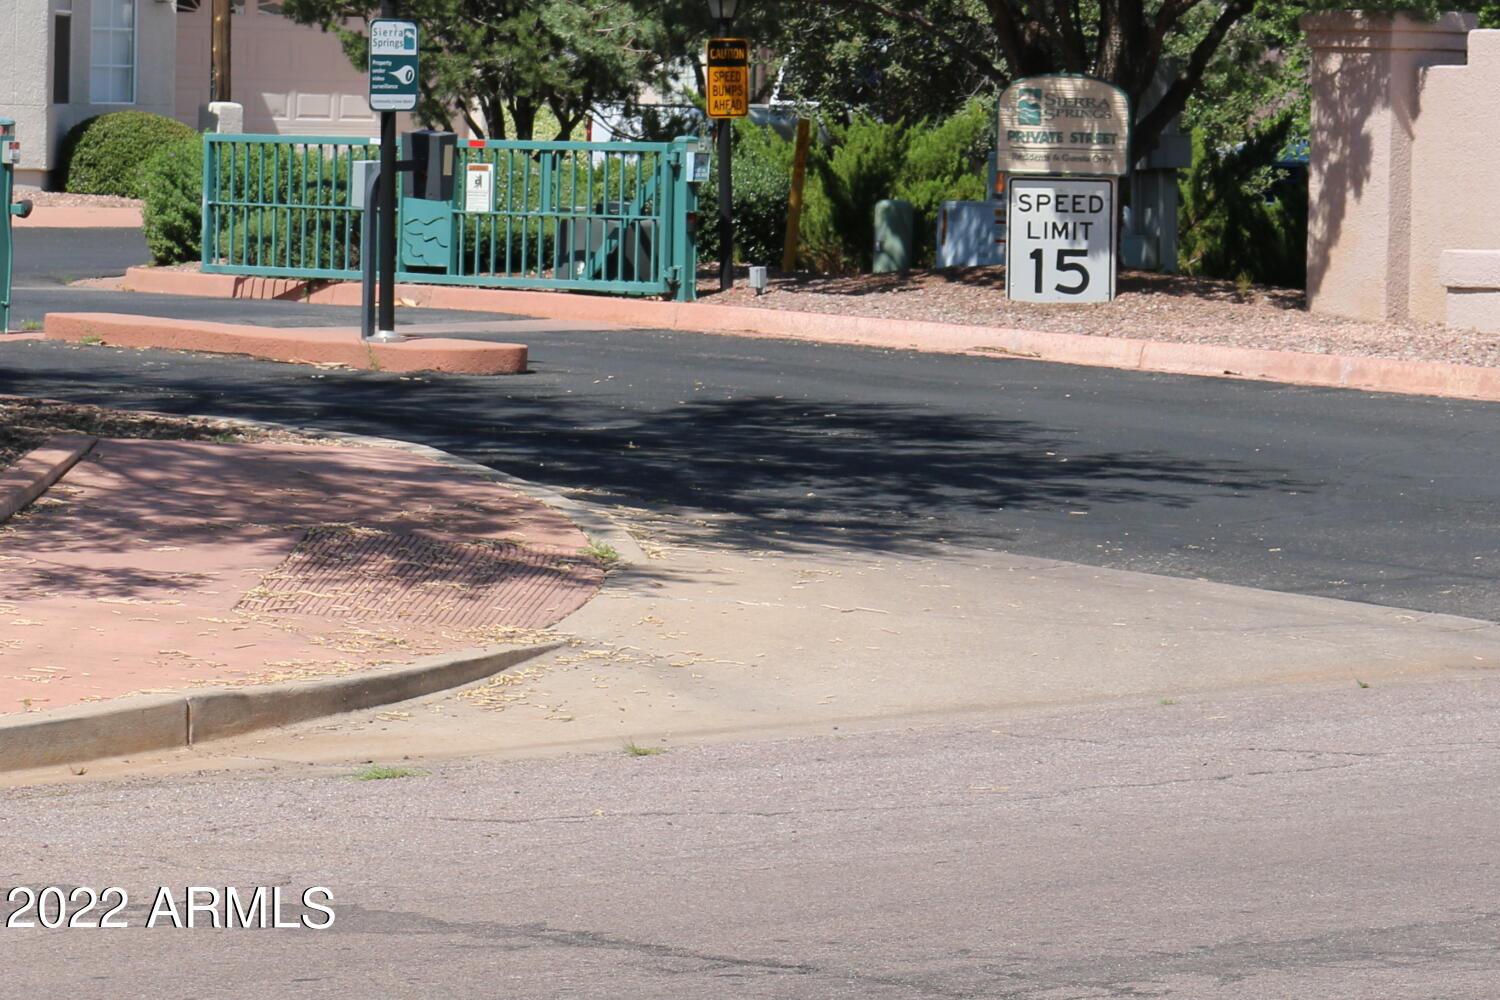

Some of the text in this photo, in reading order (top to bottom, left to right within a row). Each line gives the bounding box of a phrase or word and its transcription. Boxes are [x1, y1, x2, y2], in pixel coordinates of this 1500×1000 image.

[373, 28, 404, 37] Sierra
[373, 38, 404, 49] Springs
[710, 48, 745, 60] CAUTION
[713, 71, 742, 82] SPEED
[713, 85, 743, 96] BUMPS
[714, 99, 742, 111] AHEAD
[1044, 92, 1111, 109] SIERRA
[1044, 107, 1112, 120] SPRINGS
[1007, 130, 1118, 145] PRIVATE STREET
[1092, 154, 1113, 165] Only
[1018, 193, 1104, 213] SPEED
[1027, 221, 1093, 240] LIMIT
[1029, 248, 1090, 295] 15
